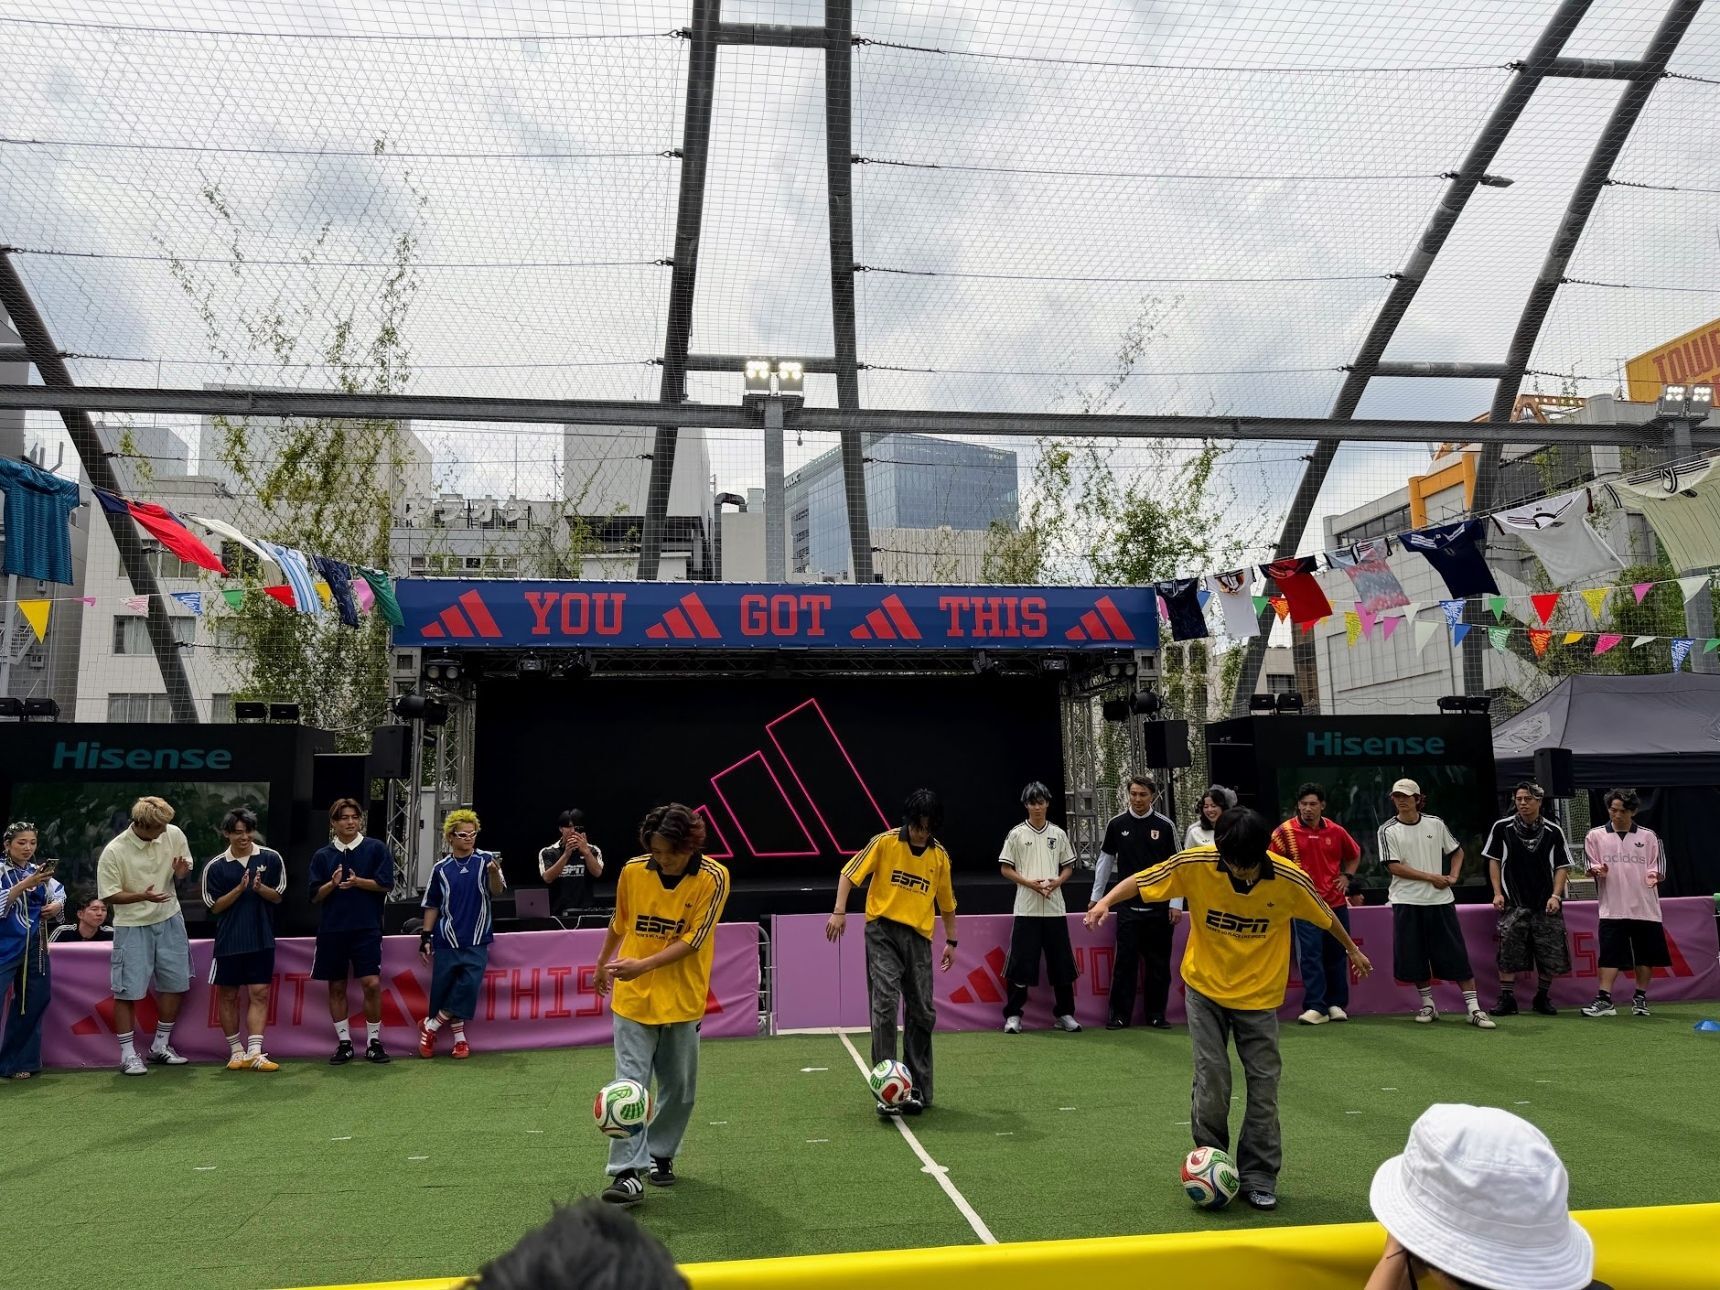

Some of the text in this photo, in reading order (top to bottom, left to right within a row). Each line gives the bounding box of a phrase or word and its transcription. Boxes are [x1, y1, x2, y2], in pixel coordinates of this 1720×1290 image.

[524, 591, 1048, 637] YOU GOT THIS
[53, 741, 232, 770] Hisense
[1307, 731, 1445, 756] Hisense
[1602, 852, 1646, 864] adidas
[891, 869, 931, 893] ESPN
[1206, 908, 1270, 934] ESPN
[483, 965, 603, 1021] THIS
